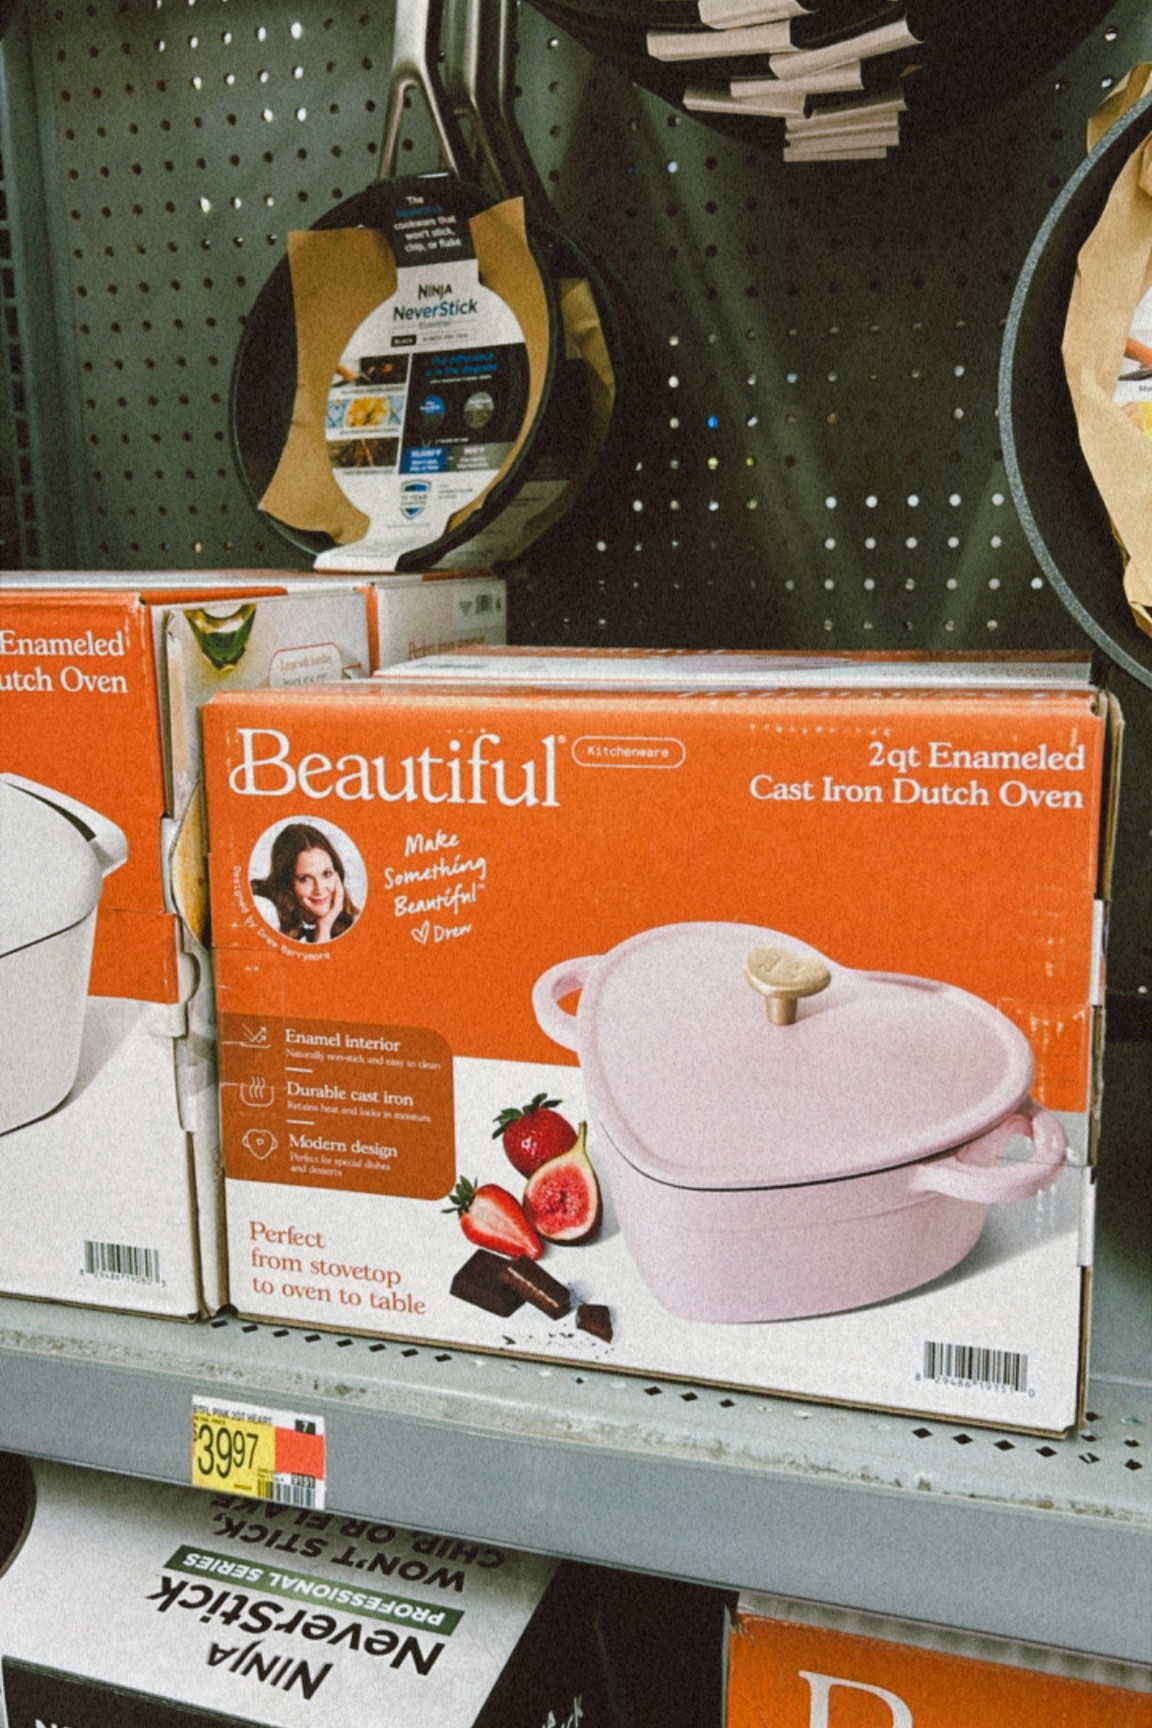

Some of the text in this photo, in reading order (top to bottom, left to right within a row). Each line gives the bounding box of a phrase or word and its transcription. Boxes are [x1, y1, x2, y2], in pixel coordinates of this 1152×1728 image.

[393, 215, 456, 230] cookware that
[418, 284, 453, 300] NINJA
[393, 298, 479, 321] NeverStick
[0, 629, 125, 656] Enameled
[60, 666, 128, 693] Oven
[587, 745, 669, 758] Kitchenware
[869, 742, 1085, 772] 2qt Enameled
[750, 774, 1084, 808] Cast Iron Dutch Oven
[405, 829, 460, 856] Make
[384, 855, 487, 889] Something
[432, 923, 473, 942] Drew
[285, 1028, 401, 1051] Enamel interior
[367, 1056, 383, 1065] and
[386, 1058, 403, 1068] easy
[406, 1058, 416, 1067] to
[418, 1060, 441, 1070] clean
[287, 1081, 414, 1106] Durable cast iron
[341, 1105, 357, 1115] and
[384, 1109, 392, 1118] in
[289, 1133, 398, 1159] Modern design
[290, 1152, 391, 1171] Perfect for special dishes
[290, 1164, 342, 1177] and desserts
[250, 1220, 325, 1249] Perfect
[251, 1247, 401, 1289] from stovetop
[252, 1277, 426, 1315] to oven to table
[340, 1516, 396, 1539] OR
[212, 1512, 465, 1592] WON'T STICK,
[411, 1530, 505, 1569] CHIP,
[183, 1551, 446, 1626] PROFESSIONAL SERIES
[145, 1575, 445, 1676] NeverStick
[206, 1641, 332, 1700] NINJA
